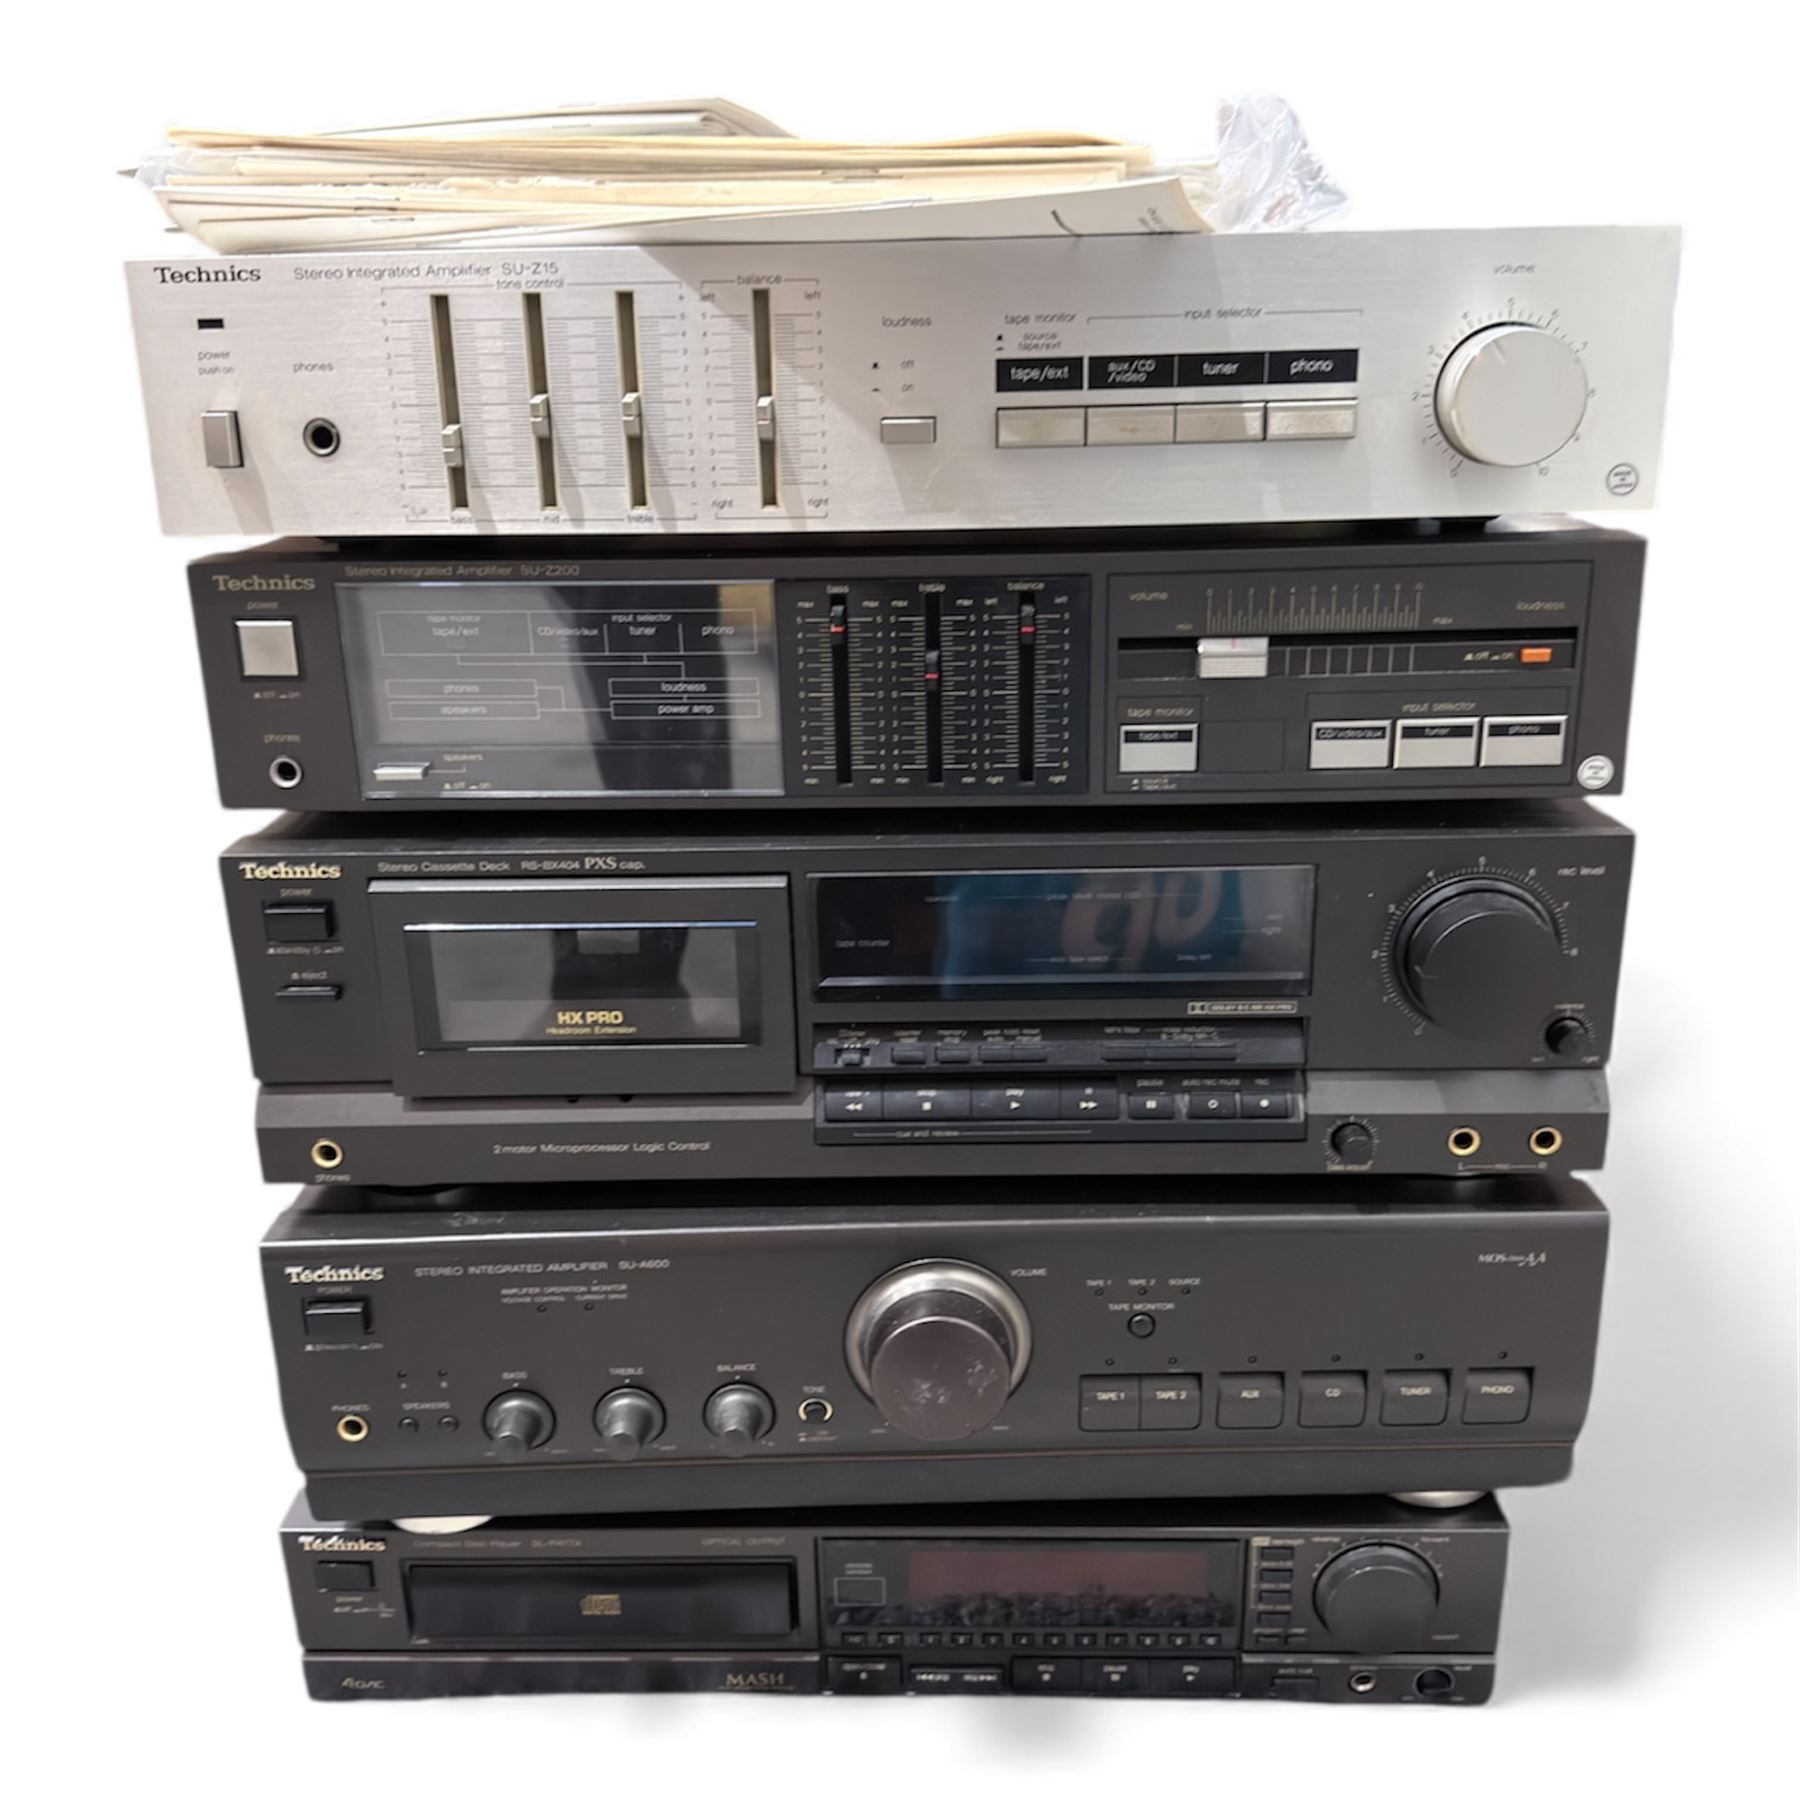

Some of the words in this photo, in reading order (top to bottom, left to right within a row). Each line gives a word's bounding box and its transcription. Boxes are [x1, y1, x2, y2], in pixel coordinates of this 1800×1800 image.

[154, 265, 262, 283] Technics
[293, 267, 343, 280] Stereo
[346, 265, 420, 282] Integrated
[426, 264, 491, 280] Amplifier
[501, 262, 559, 276] SU-Z15
[736, 274, 782, 285] balance
[881, 315, 933, 328] loudness
[1004, 313, 1030, 325] tape
[1034, 312, 1077, 323] monitor
[1010, 365, 1070, 382] tape/ext
[1202, 362, 1240, 376] tuner
[1290, 359, 1334, 378] phono
[344, 566, 387, 577] Stereo
[390, 565, 453, 579] Integrated
[456, 565, 512, 578] Amplifier
[520, 564, 580, 577] SU-Z200
[212, 575, 315, 591] Technics
[629, 625, 656, 636] tuner
[701, 625, 734, 637] phono
[239, 861, 342, 880] Technics
[377, 862, 418, 873] Stereo
[421, 861, 475, 872] Cassette
[479, 860, 510, 872] Deck
[584, 856, 617, 870] PXS
[557, 1011, 585, 1024] HX
[586, 1010, 624, 1024] PRO
[540, 1142, 630, 1156] Microprocessor
[633, 1141, 665, 1153] Logic
[668, 1140, 710, 1152] Control
[284, 1264, 384, 1284] Technics
[414, 1266, 464, 1278] STEREO
[468, 1264, 544, 1275] INTEGRATED
[547, 1261, 608, 1273] AMPLIFIER
[1096, 1391, 1118, 1402] TAPE
[1240, 1390, 1260, 1399] AUX
[1325, 1388, 1341, 1398] CD
[1400, 1386, 1431, 1397] TUNER
[1480, 1385, 1515, 1395] PHONO
[298, 1534, 386, 1552] Technics
[726, 1672, 785, 1687] MASH
